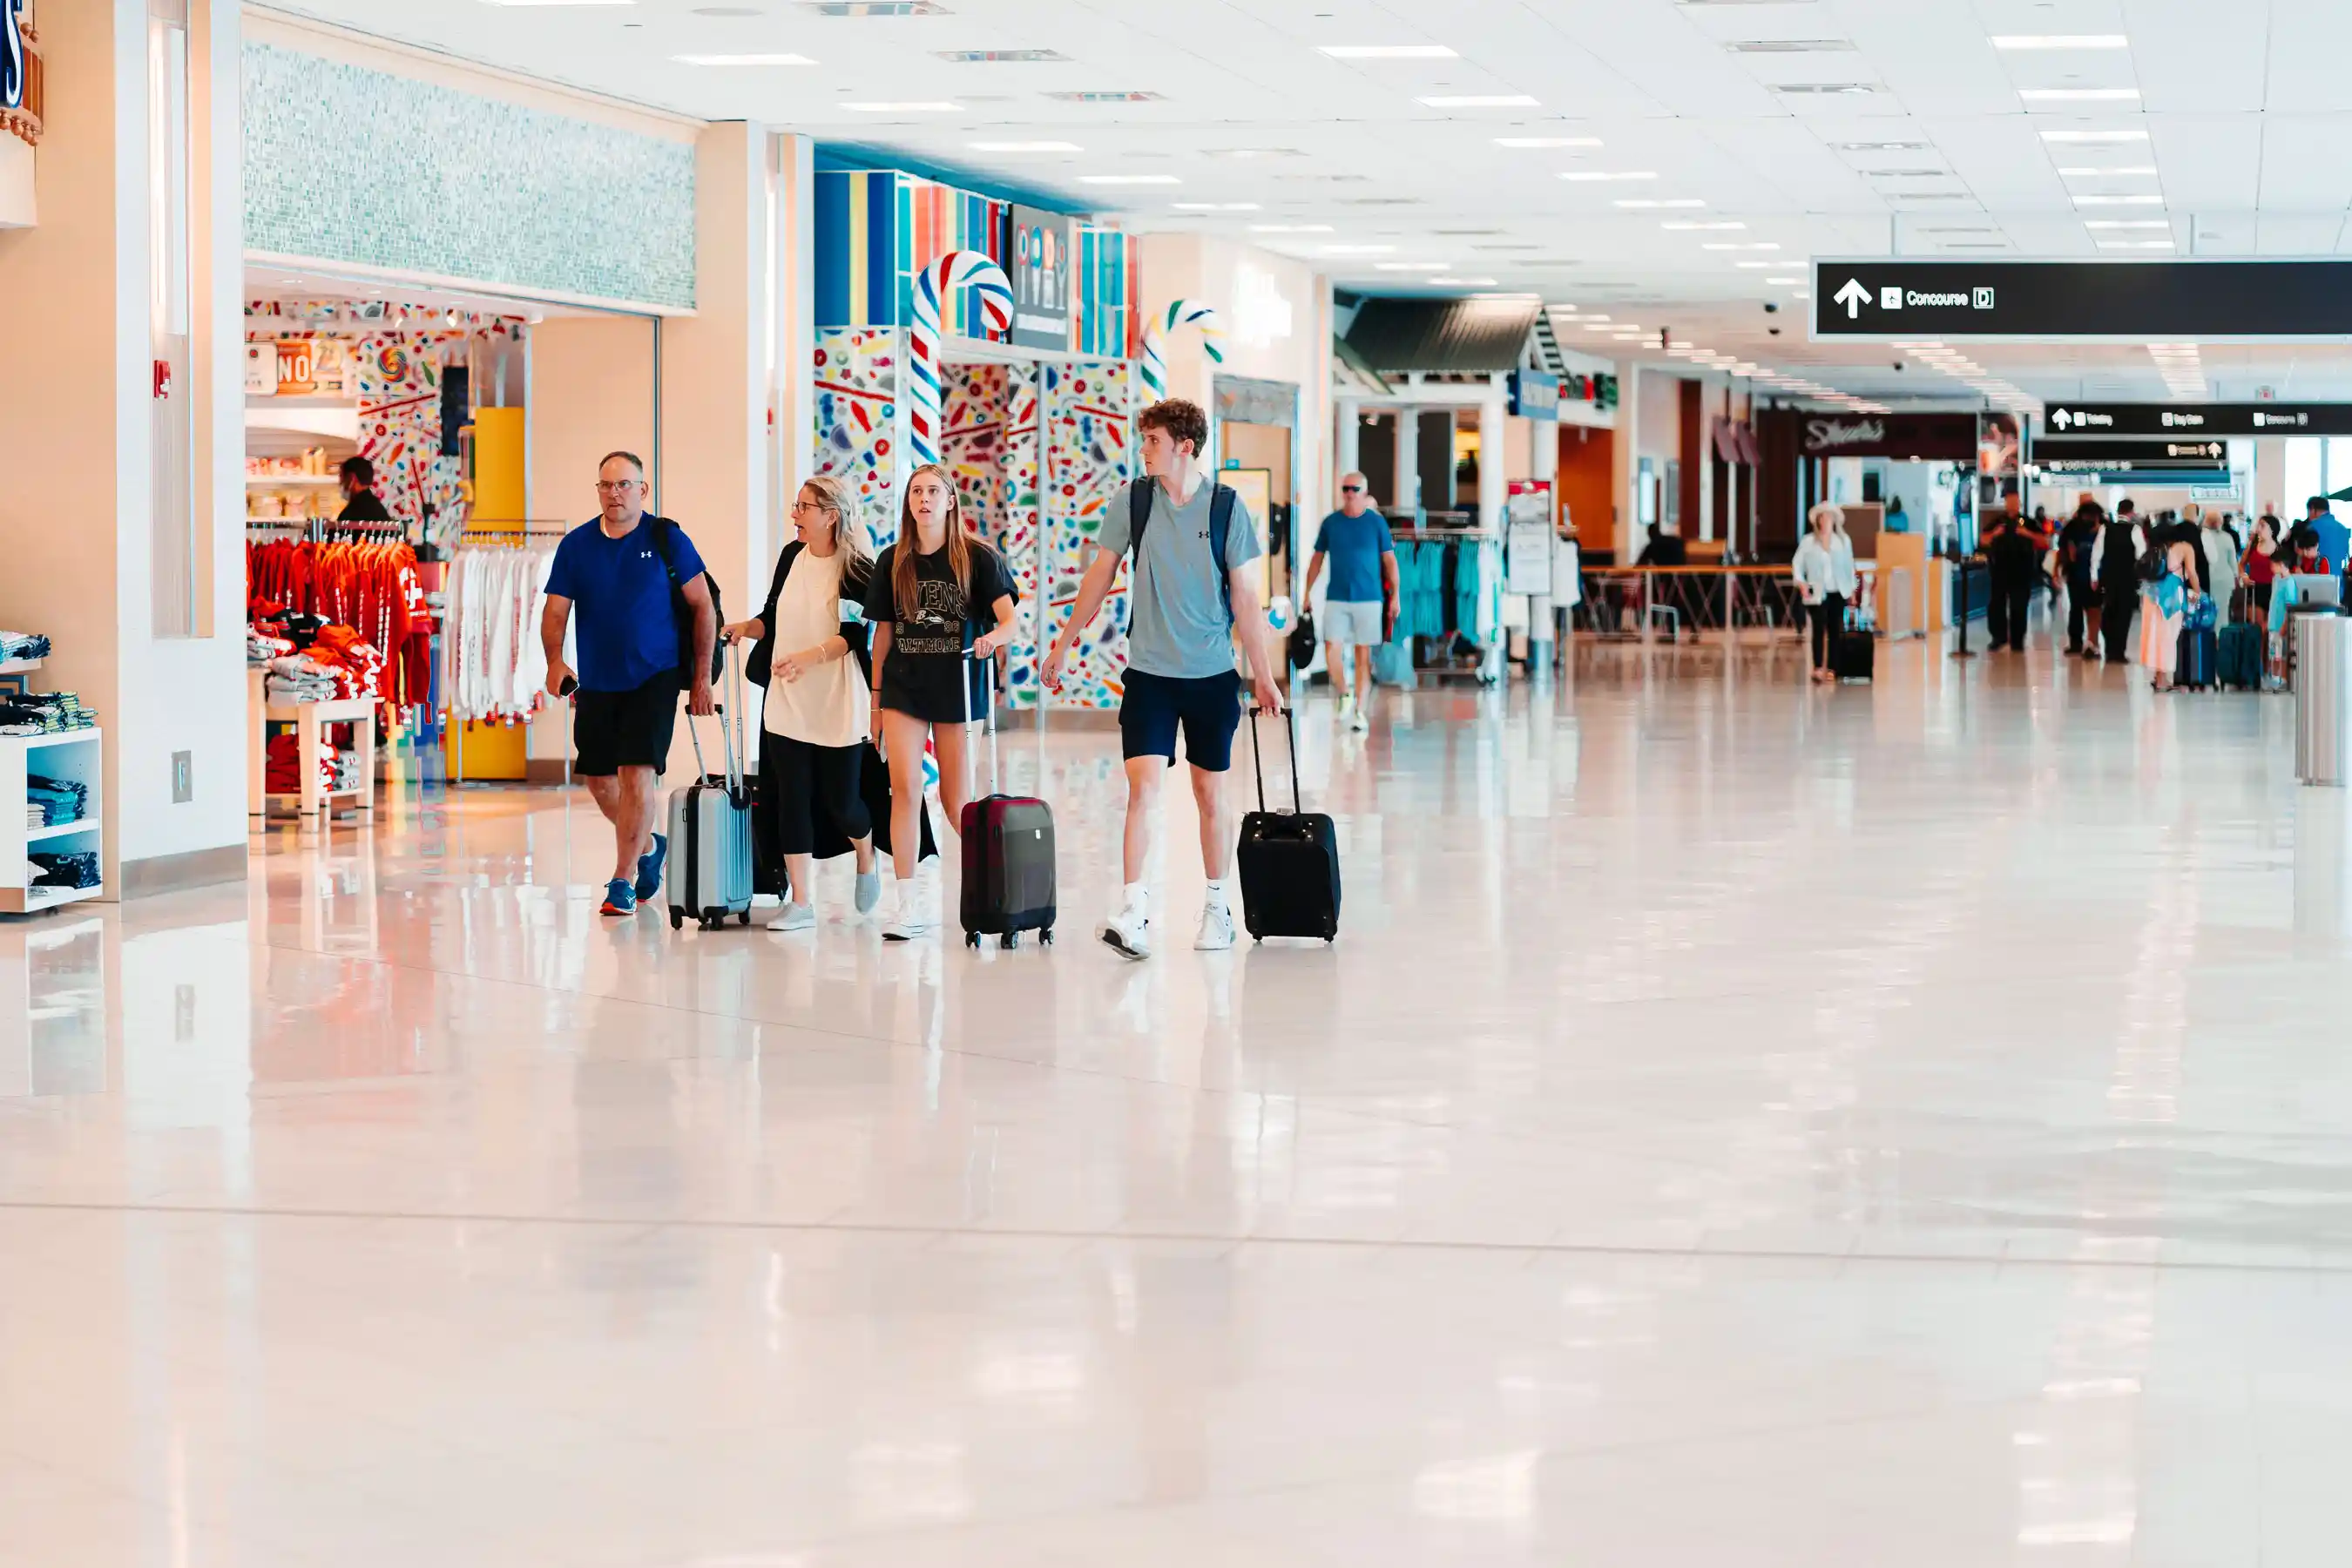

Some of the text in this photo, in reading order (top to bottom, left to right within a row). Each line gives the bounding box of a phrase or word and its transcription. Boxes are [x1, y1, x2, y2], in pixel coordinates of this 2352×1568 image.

[1906, 288, 1991, 308] Concourse D
[896, 637, 960, 653] ALTIMORE
